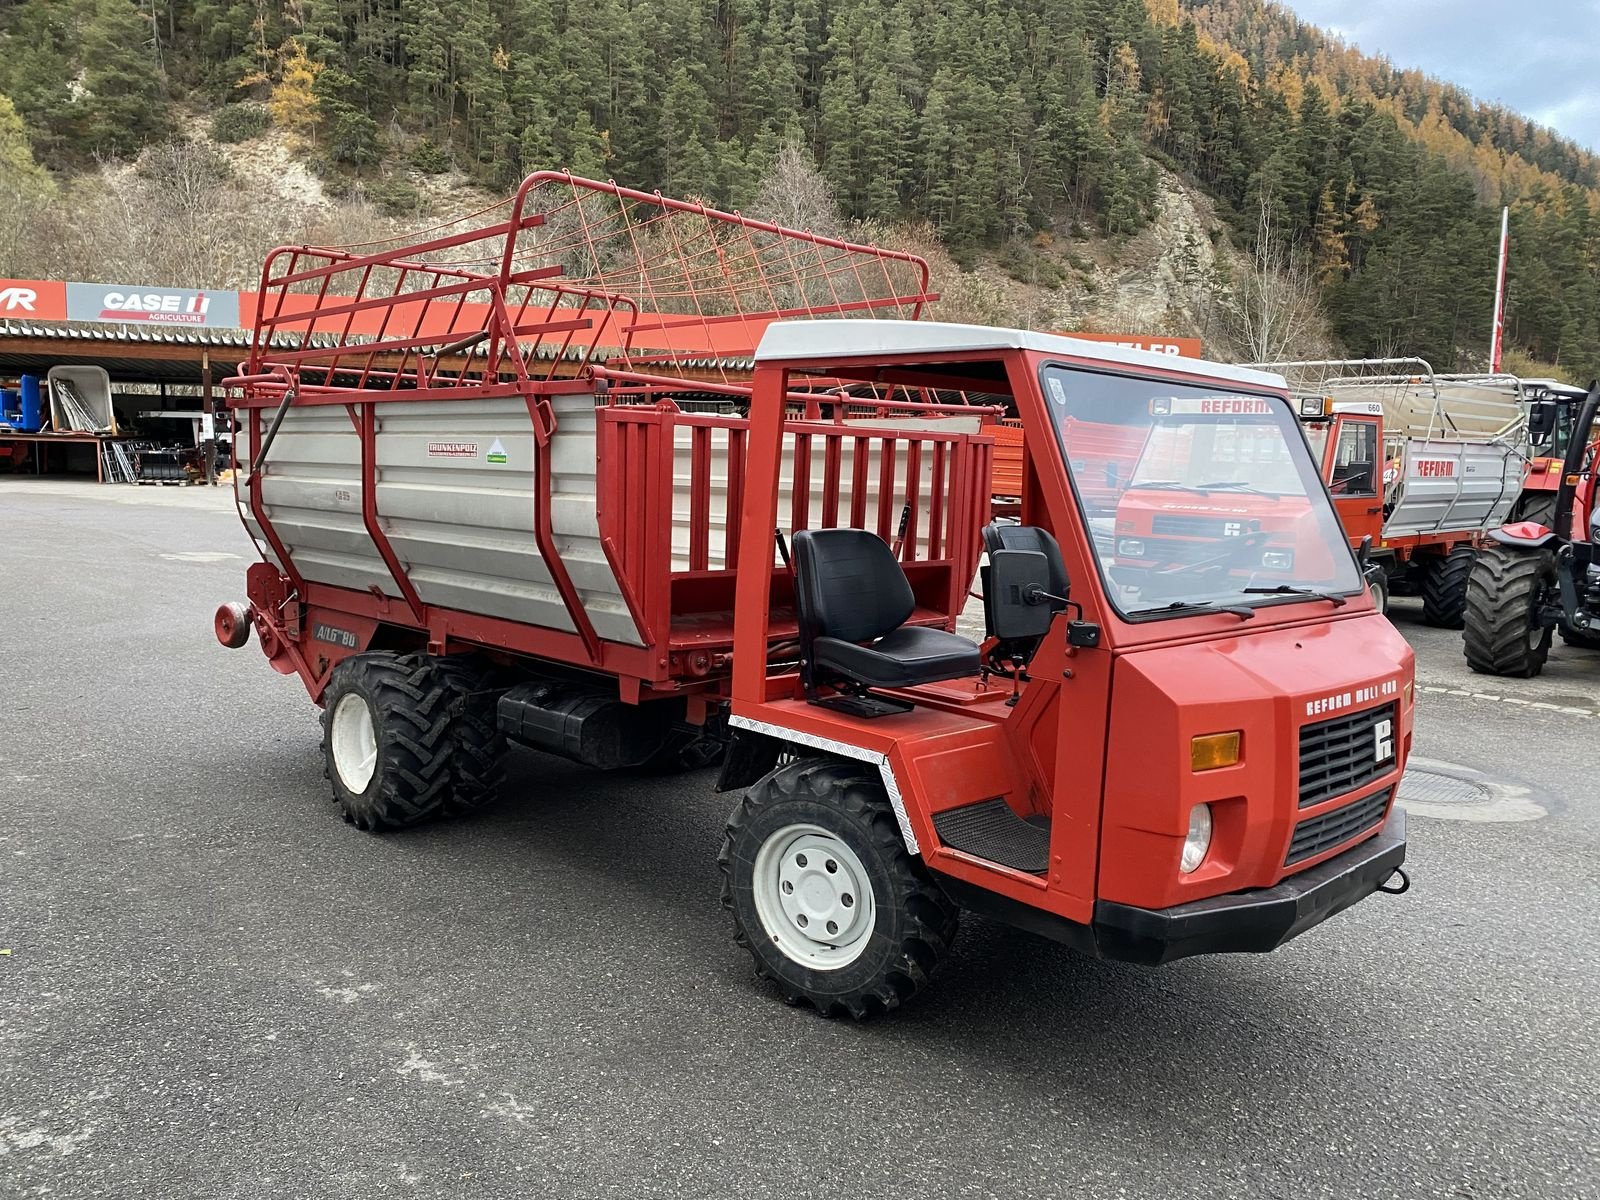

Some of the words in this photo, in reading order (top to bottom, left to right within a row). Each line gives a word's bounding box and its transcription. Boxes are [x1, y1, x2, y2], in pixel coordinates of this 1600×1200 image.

[103, 292, 181, 312] CASE
[149, 313, 202, 322] AGRICULTURE
[1201, 400, 1270, 413] REFORM
[1367, 403, 1380, 413] 660
[1418, 461, 1454, 477] REFORM
[341, 631, 356, 648] 80
[1306, 692, 1352, 716] REFORM
[1355, 685, 1378, 704] MULI
[1381, 680, 1397, 695] 400
